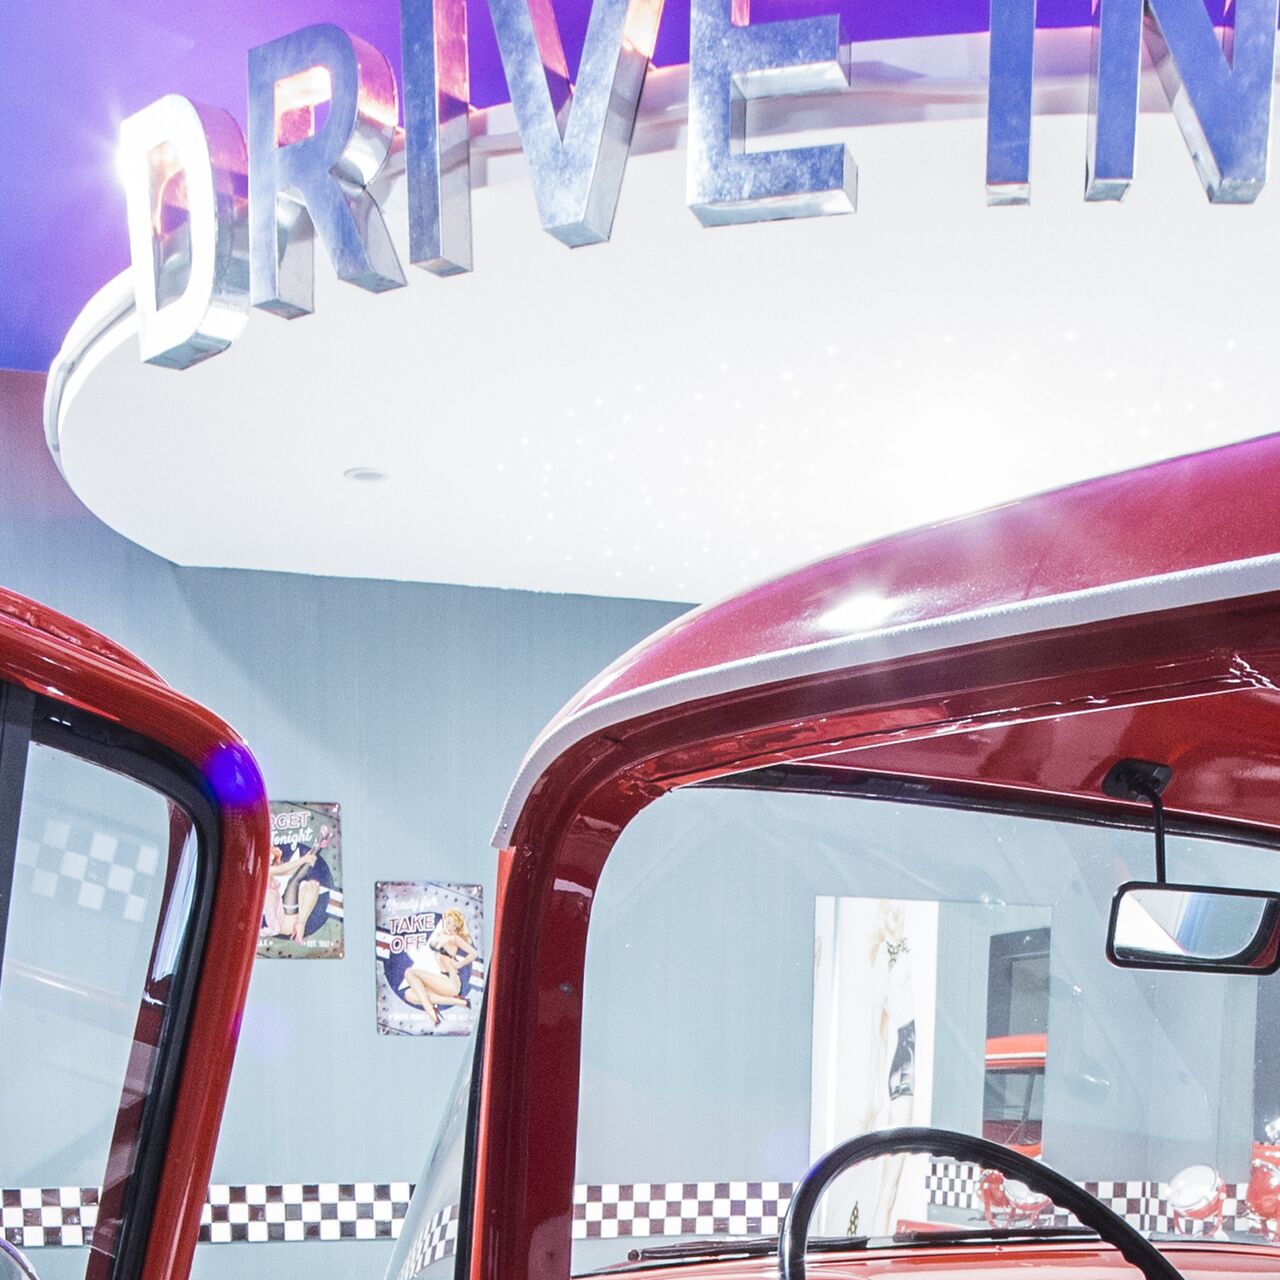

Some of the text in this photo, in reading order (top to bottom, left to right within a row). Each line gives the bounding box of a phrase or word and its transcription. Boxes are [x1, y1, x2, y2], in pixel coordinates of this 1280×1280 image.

[120, 0, 1280, 370] DRIVE IN
[389, 913, 435, 935] TAKE
[389, 933, 427, 954] OFF
